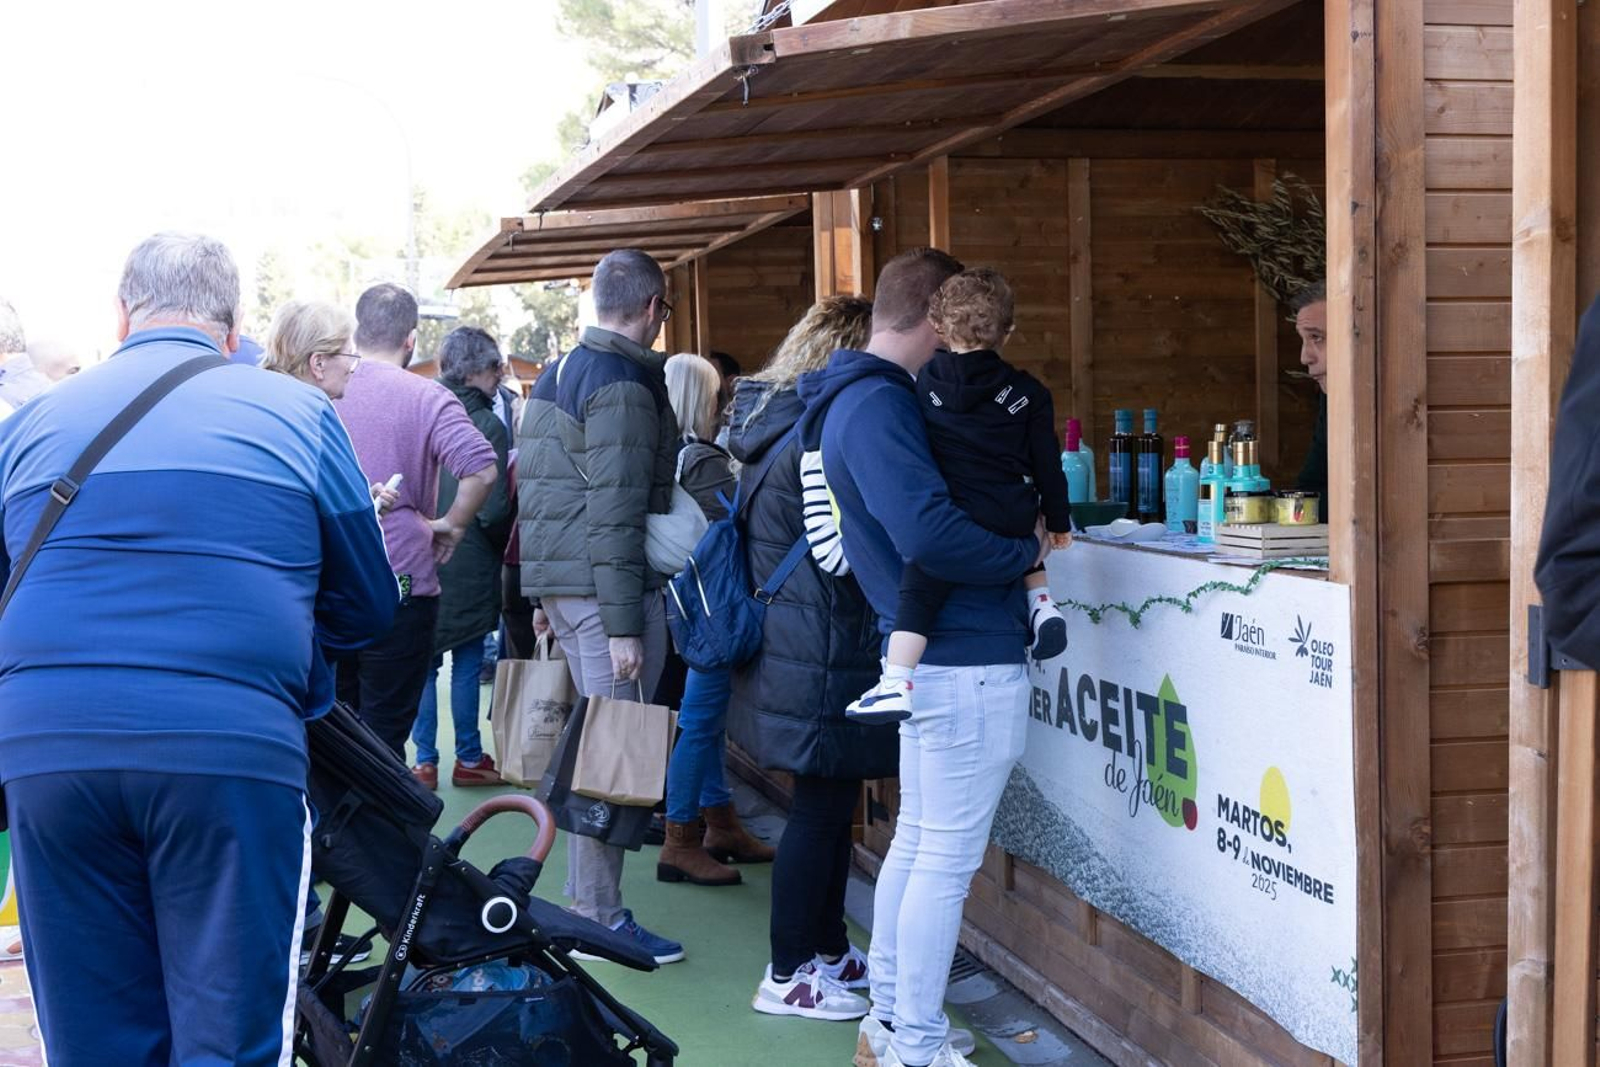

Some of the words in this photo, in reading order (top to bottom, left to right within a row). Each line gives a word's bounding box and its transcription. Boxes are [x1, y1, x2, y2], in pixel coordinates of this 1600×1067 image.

[1235, 615, 1265, 646] Jaén
[1311, 639, 1334, 657] OLEO
[1311, 654, 1333, 673] TOUR
[1056, 667, 1188, 780] ACEITE
[1104, 750, 1128, 793] de
[1128, 739, 1180, 818] Jaén
[1217, 793, 1292, 854] MARTOS,
[1217, 826, 1241, 860] 8-9
[1250, 850, 1334, 905] NOVIEMBRE
[1251, 873, 1277, 901] 2025
[402, 893, 426, 944] Kinderkraft
